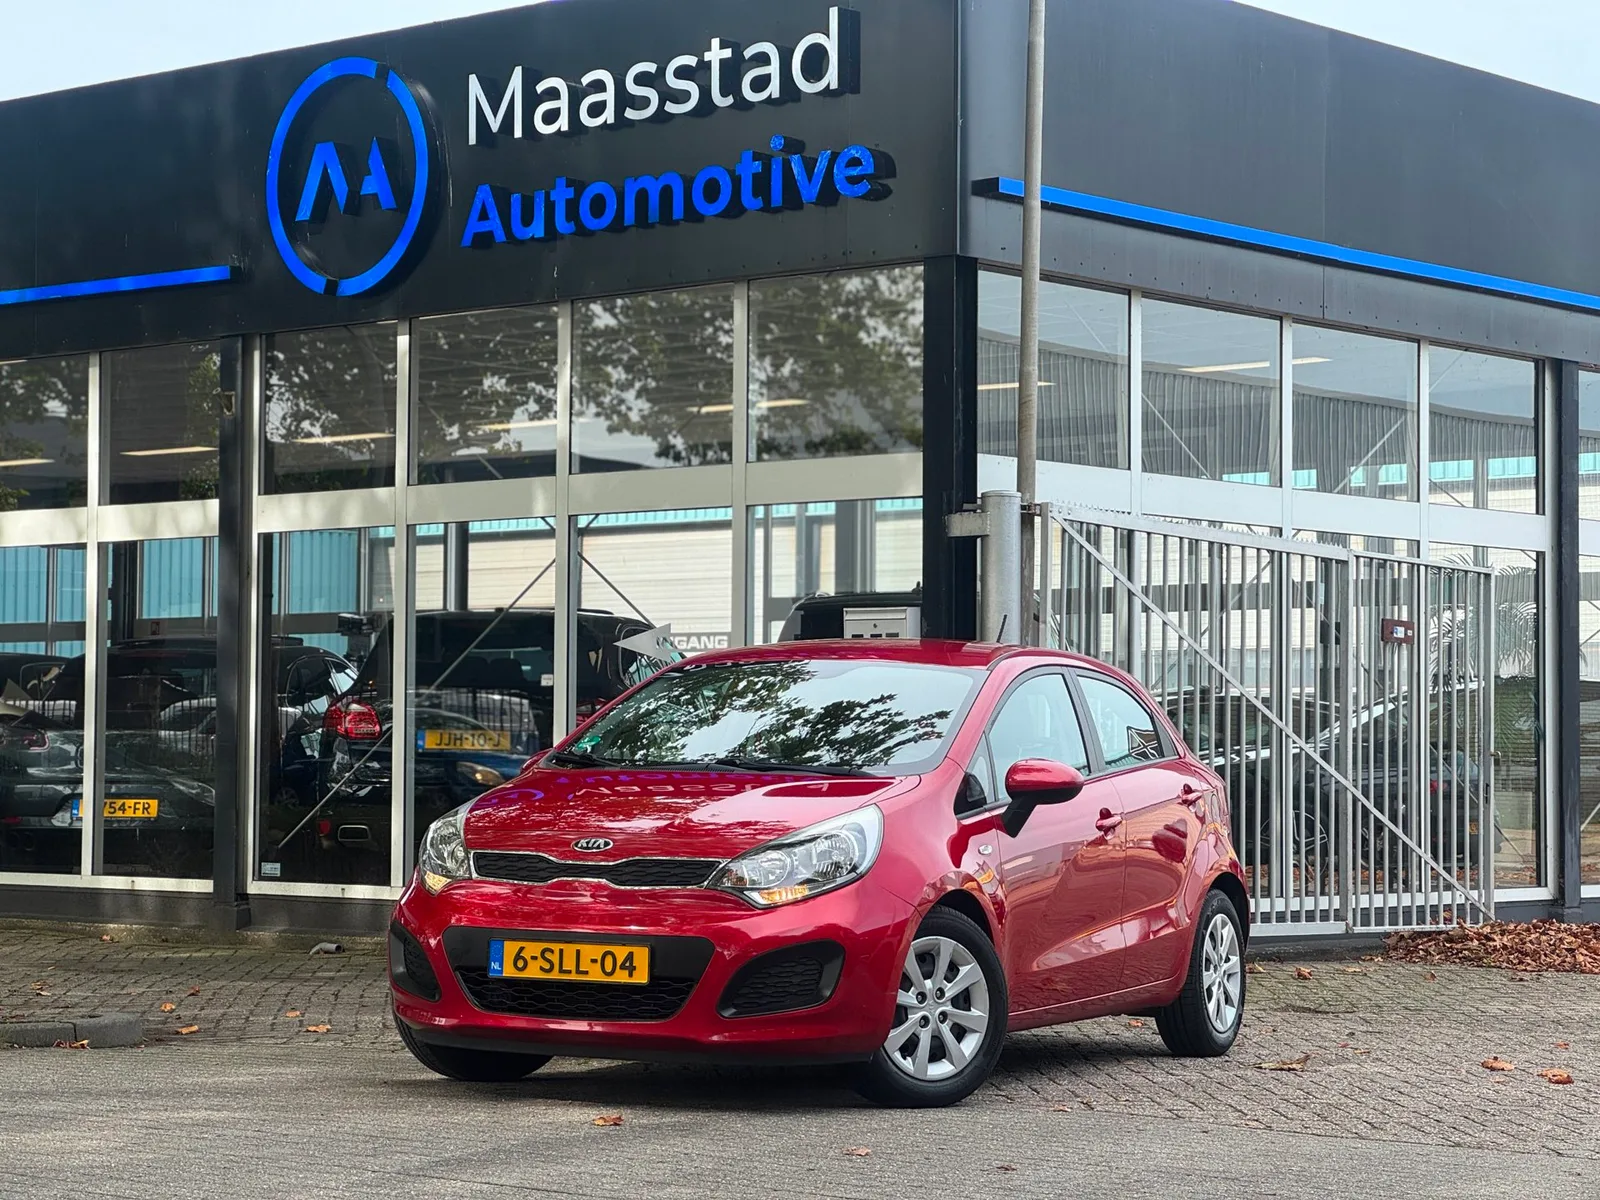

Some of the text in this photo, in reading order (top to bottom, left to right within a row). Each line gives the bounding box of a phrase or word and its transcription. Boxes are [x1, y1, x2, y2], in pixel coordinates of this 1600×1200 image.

[468, 6, 839, 146] Maasstad
[460, 134, 875, 248] Automotive
[577, 838, 605, 848] KIA
[490, 946, 636, 978] NL 6-SLL-04
